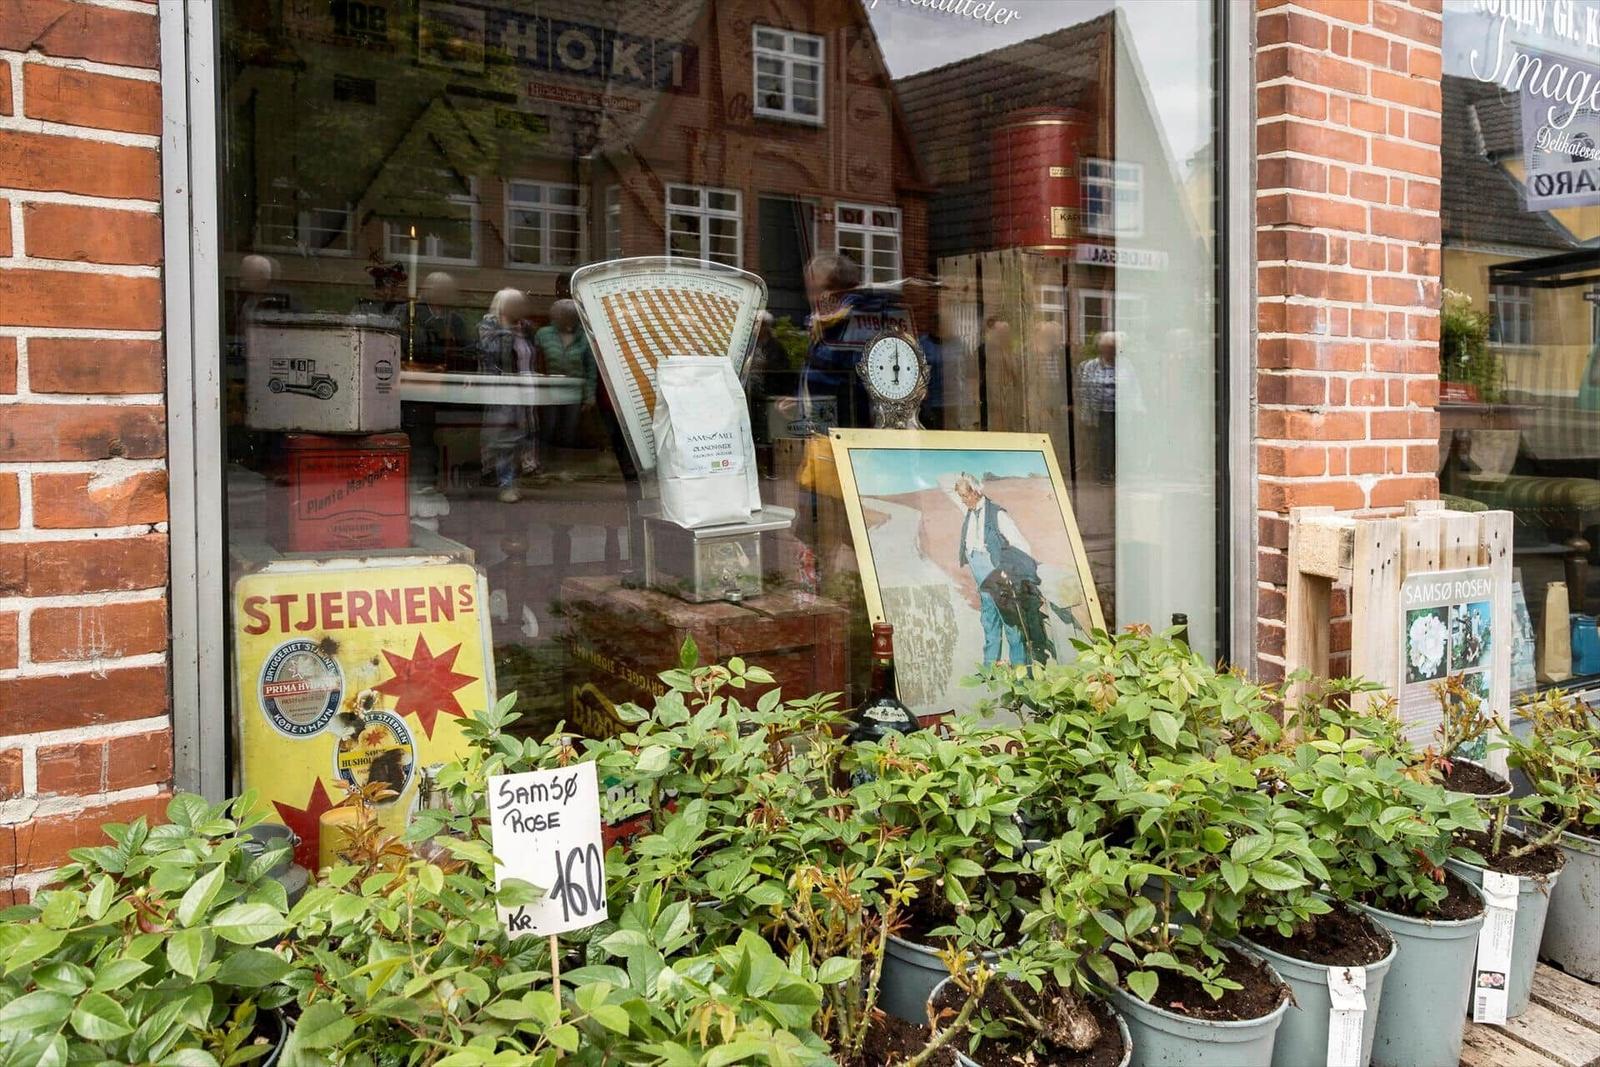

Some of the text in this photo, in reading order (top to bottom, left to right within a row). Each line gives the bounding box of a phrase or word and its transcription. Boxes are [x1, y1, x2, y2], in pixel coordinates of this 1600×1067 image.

[1586, 6, 1600, 47] K
[1406, 578, 1492, 604] SAMSØ ROSEN
[265, 643, 302, 682] BRYGGERIET
[265, 684, 297, 694] PRIMA
[274, 707, 334, 734] KØBENHAVN
[497, 772, 578, 810] SAMSØ
[503, 808, 561, 833] ROSE
